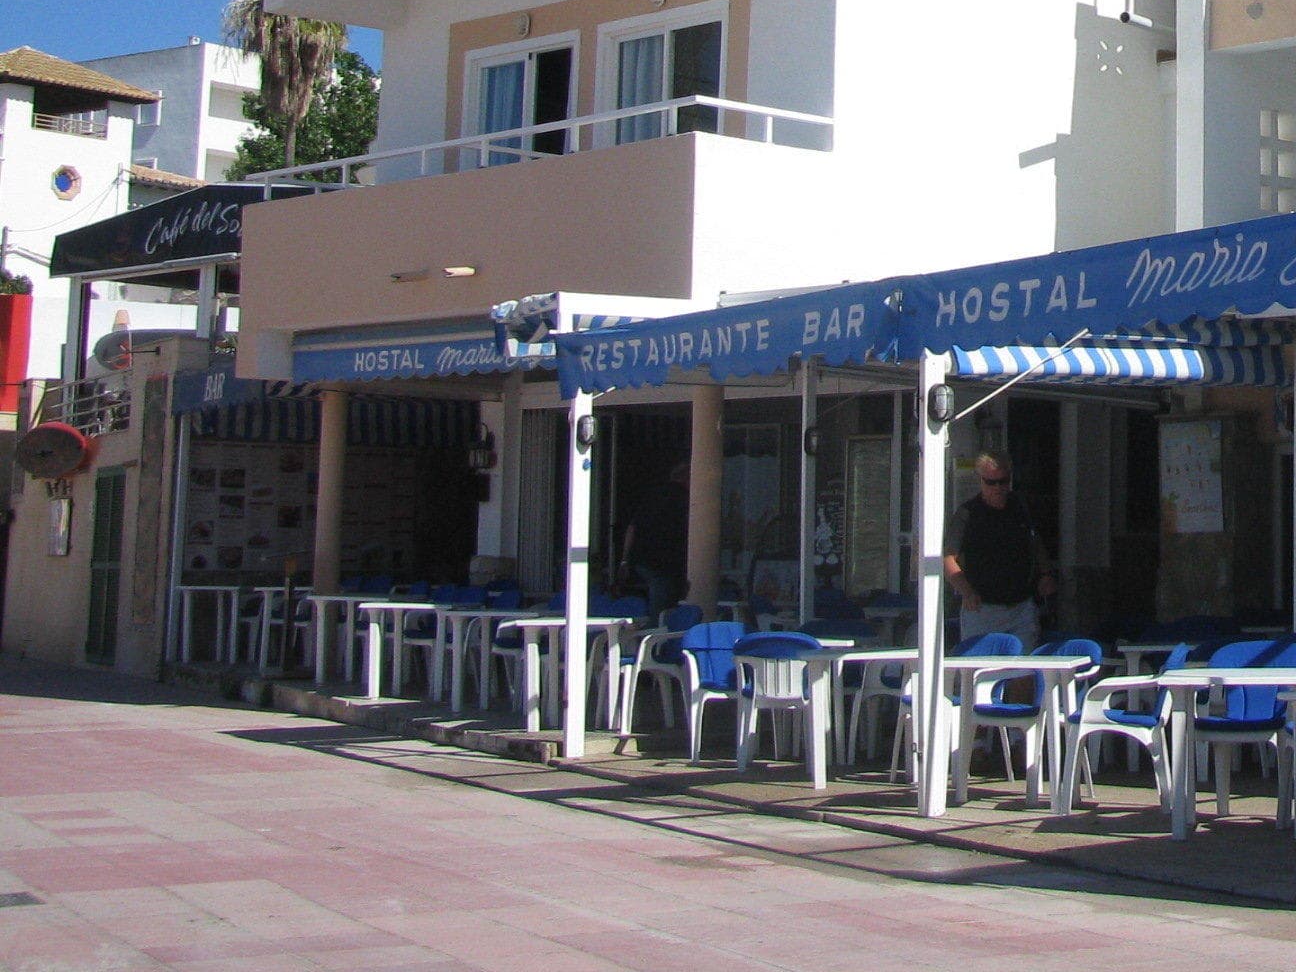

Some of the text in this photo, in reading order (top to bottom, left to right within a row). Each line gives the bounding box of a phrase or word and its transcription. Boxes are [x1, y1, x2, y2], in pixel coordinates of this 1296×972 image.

[145, 201, 242, 254] Café del So
[936, 271, 1097, 327] HOSTAL
[354, 349, 424, 372] HOSTAL
[580, 303, 866, 372] RESTAURANTE BAR
[204, 372, 225, 401] BAR
